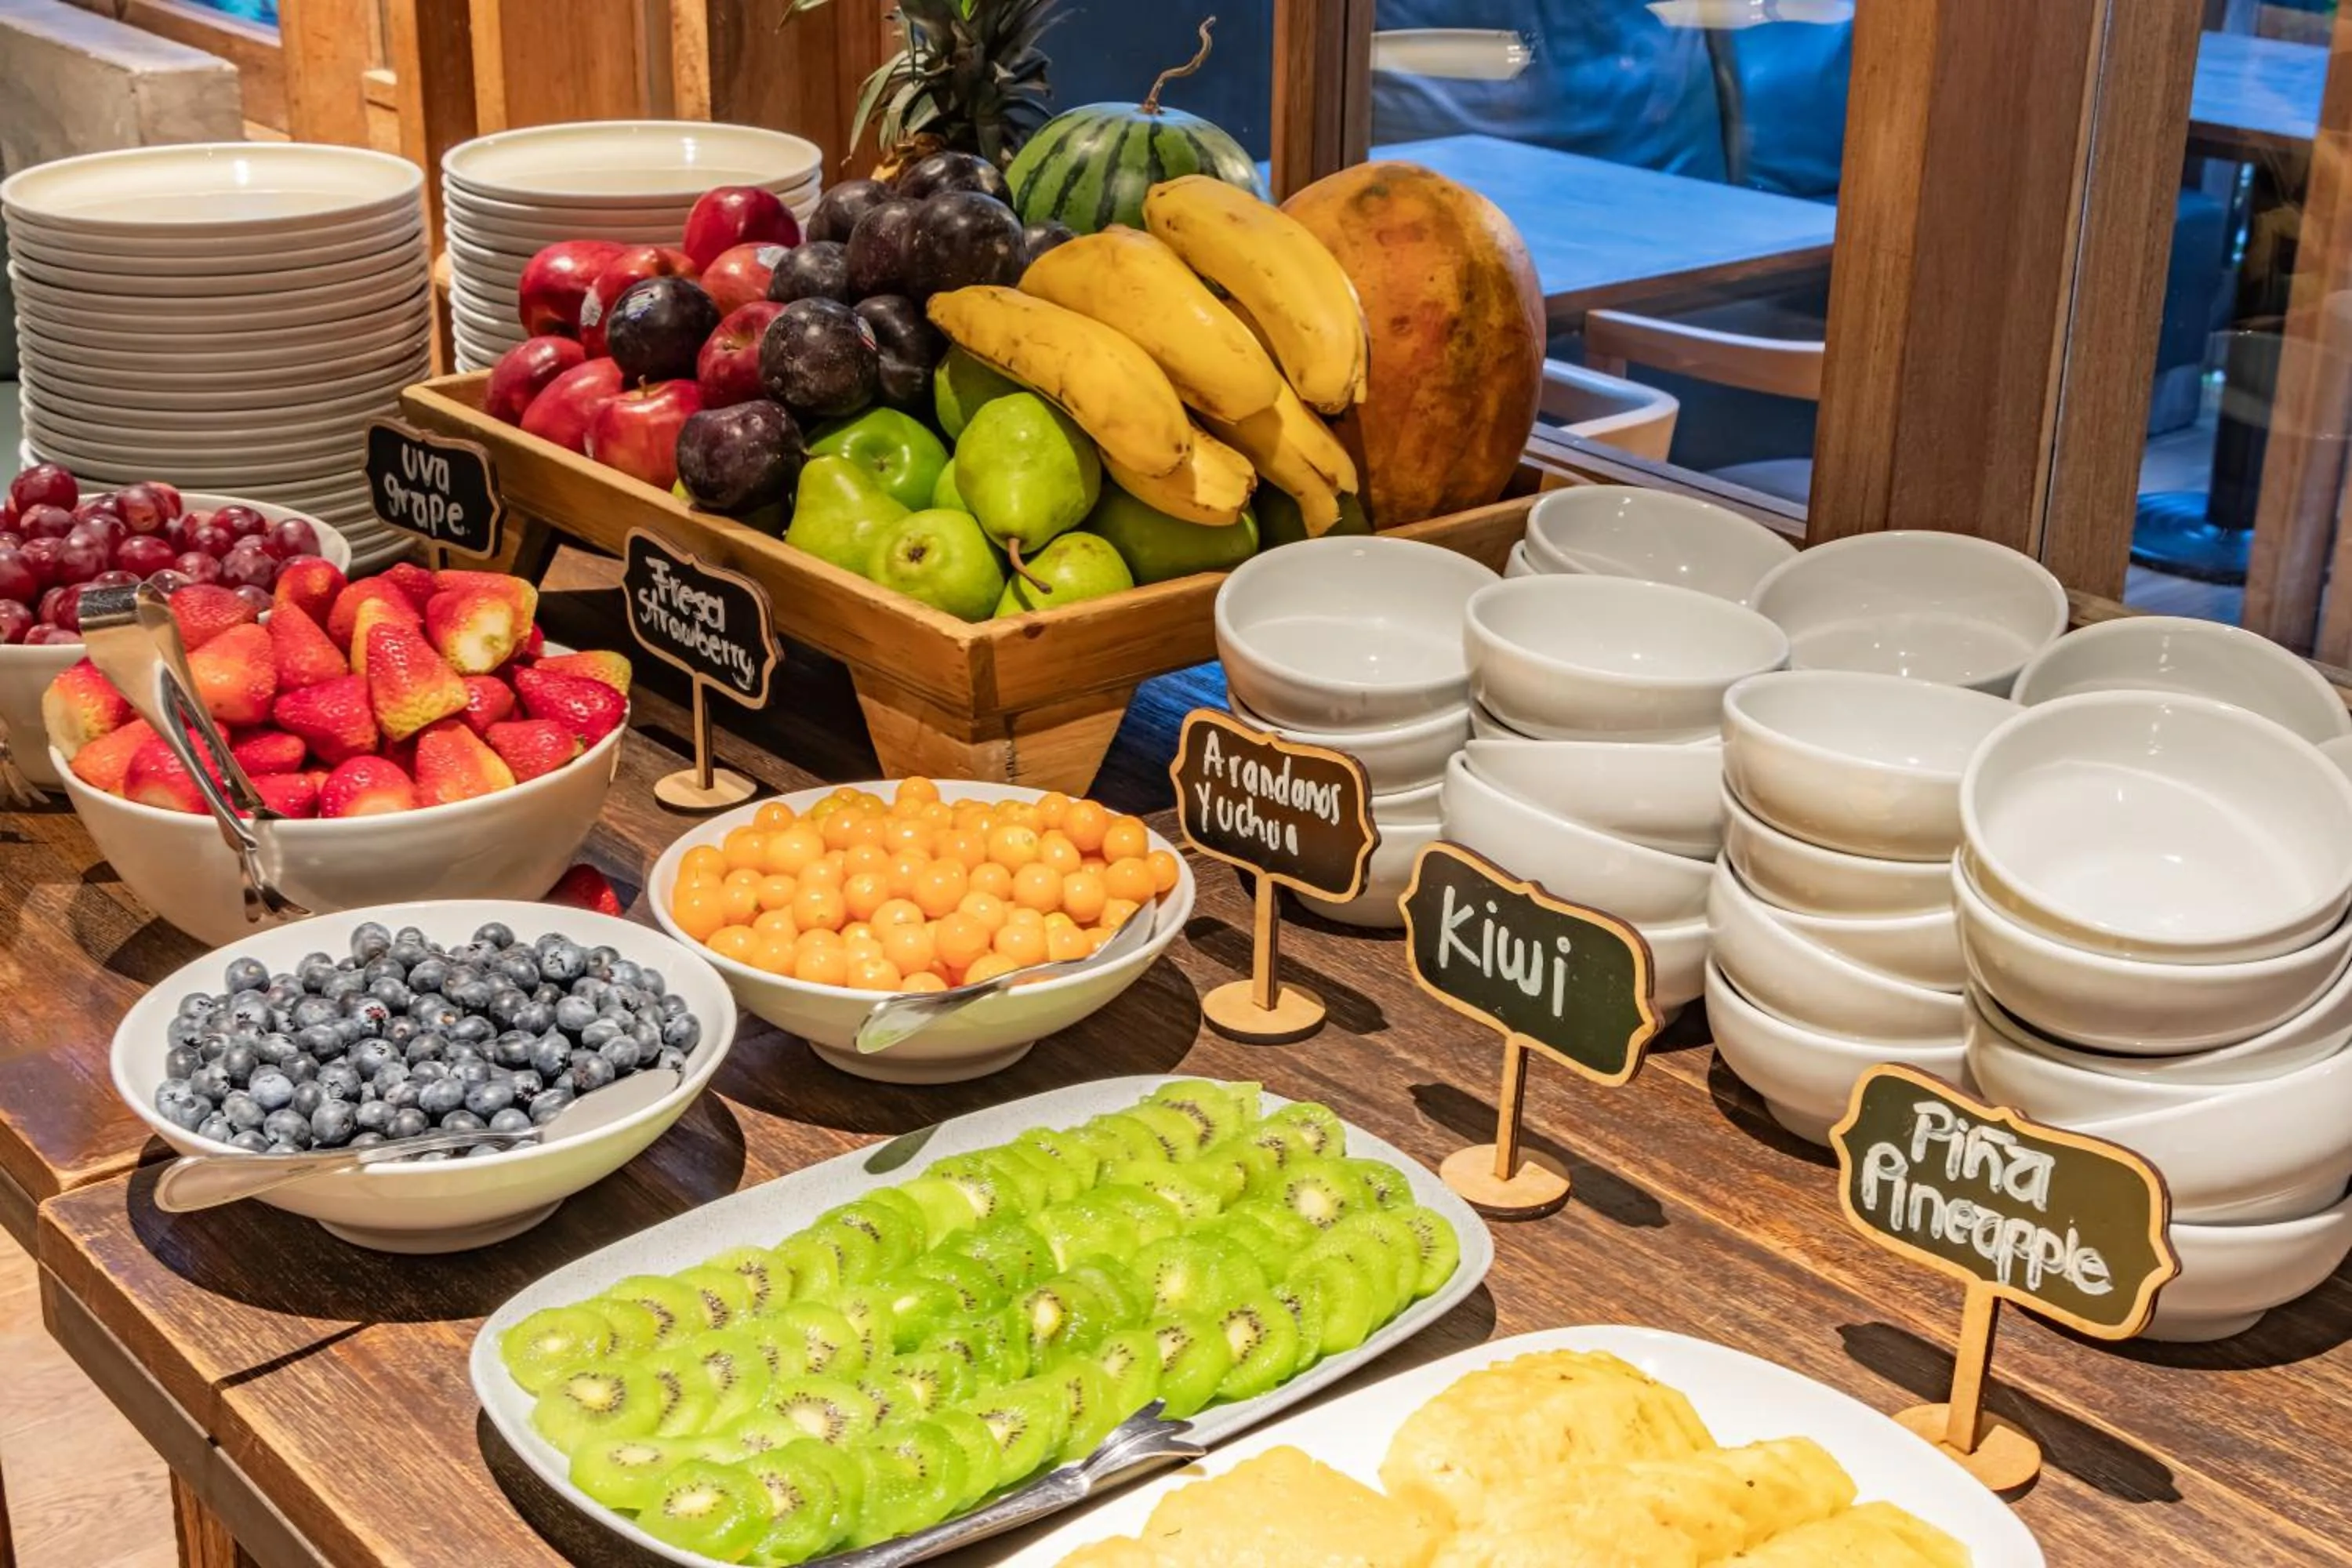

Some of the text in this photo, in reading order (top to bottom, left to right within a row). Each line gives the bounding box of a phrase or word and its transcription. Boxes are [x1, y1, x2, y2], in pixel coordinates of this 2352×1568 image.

[1203, 731, 1341, 826] Arandanos
[1438, 885, 1571, 1017] Kiwi
[1911, 1102, 2056, 1212] Piña
[1861, 1142, 2114, 1295] Pineapple
